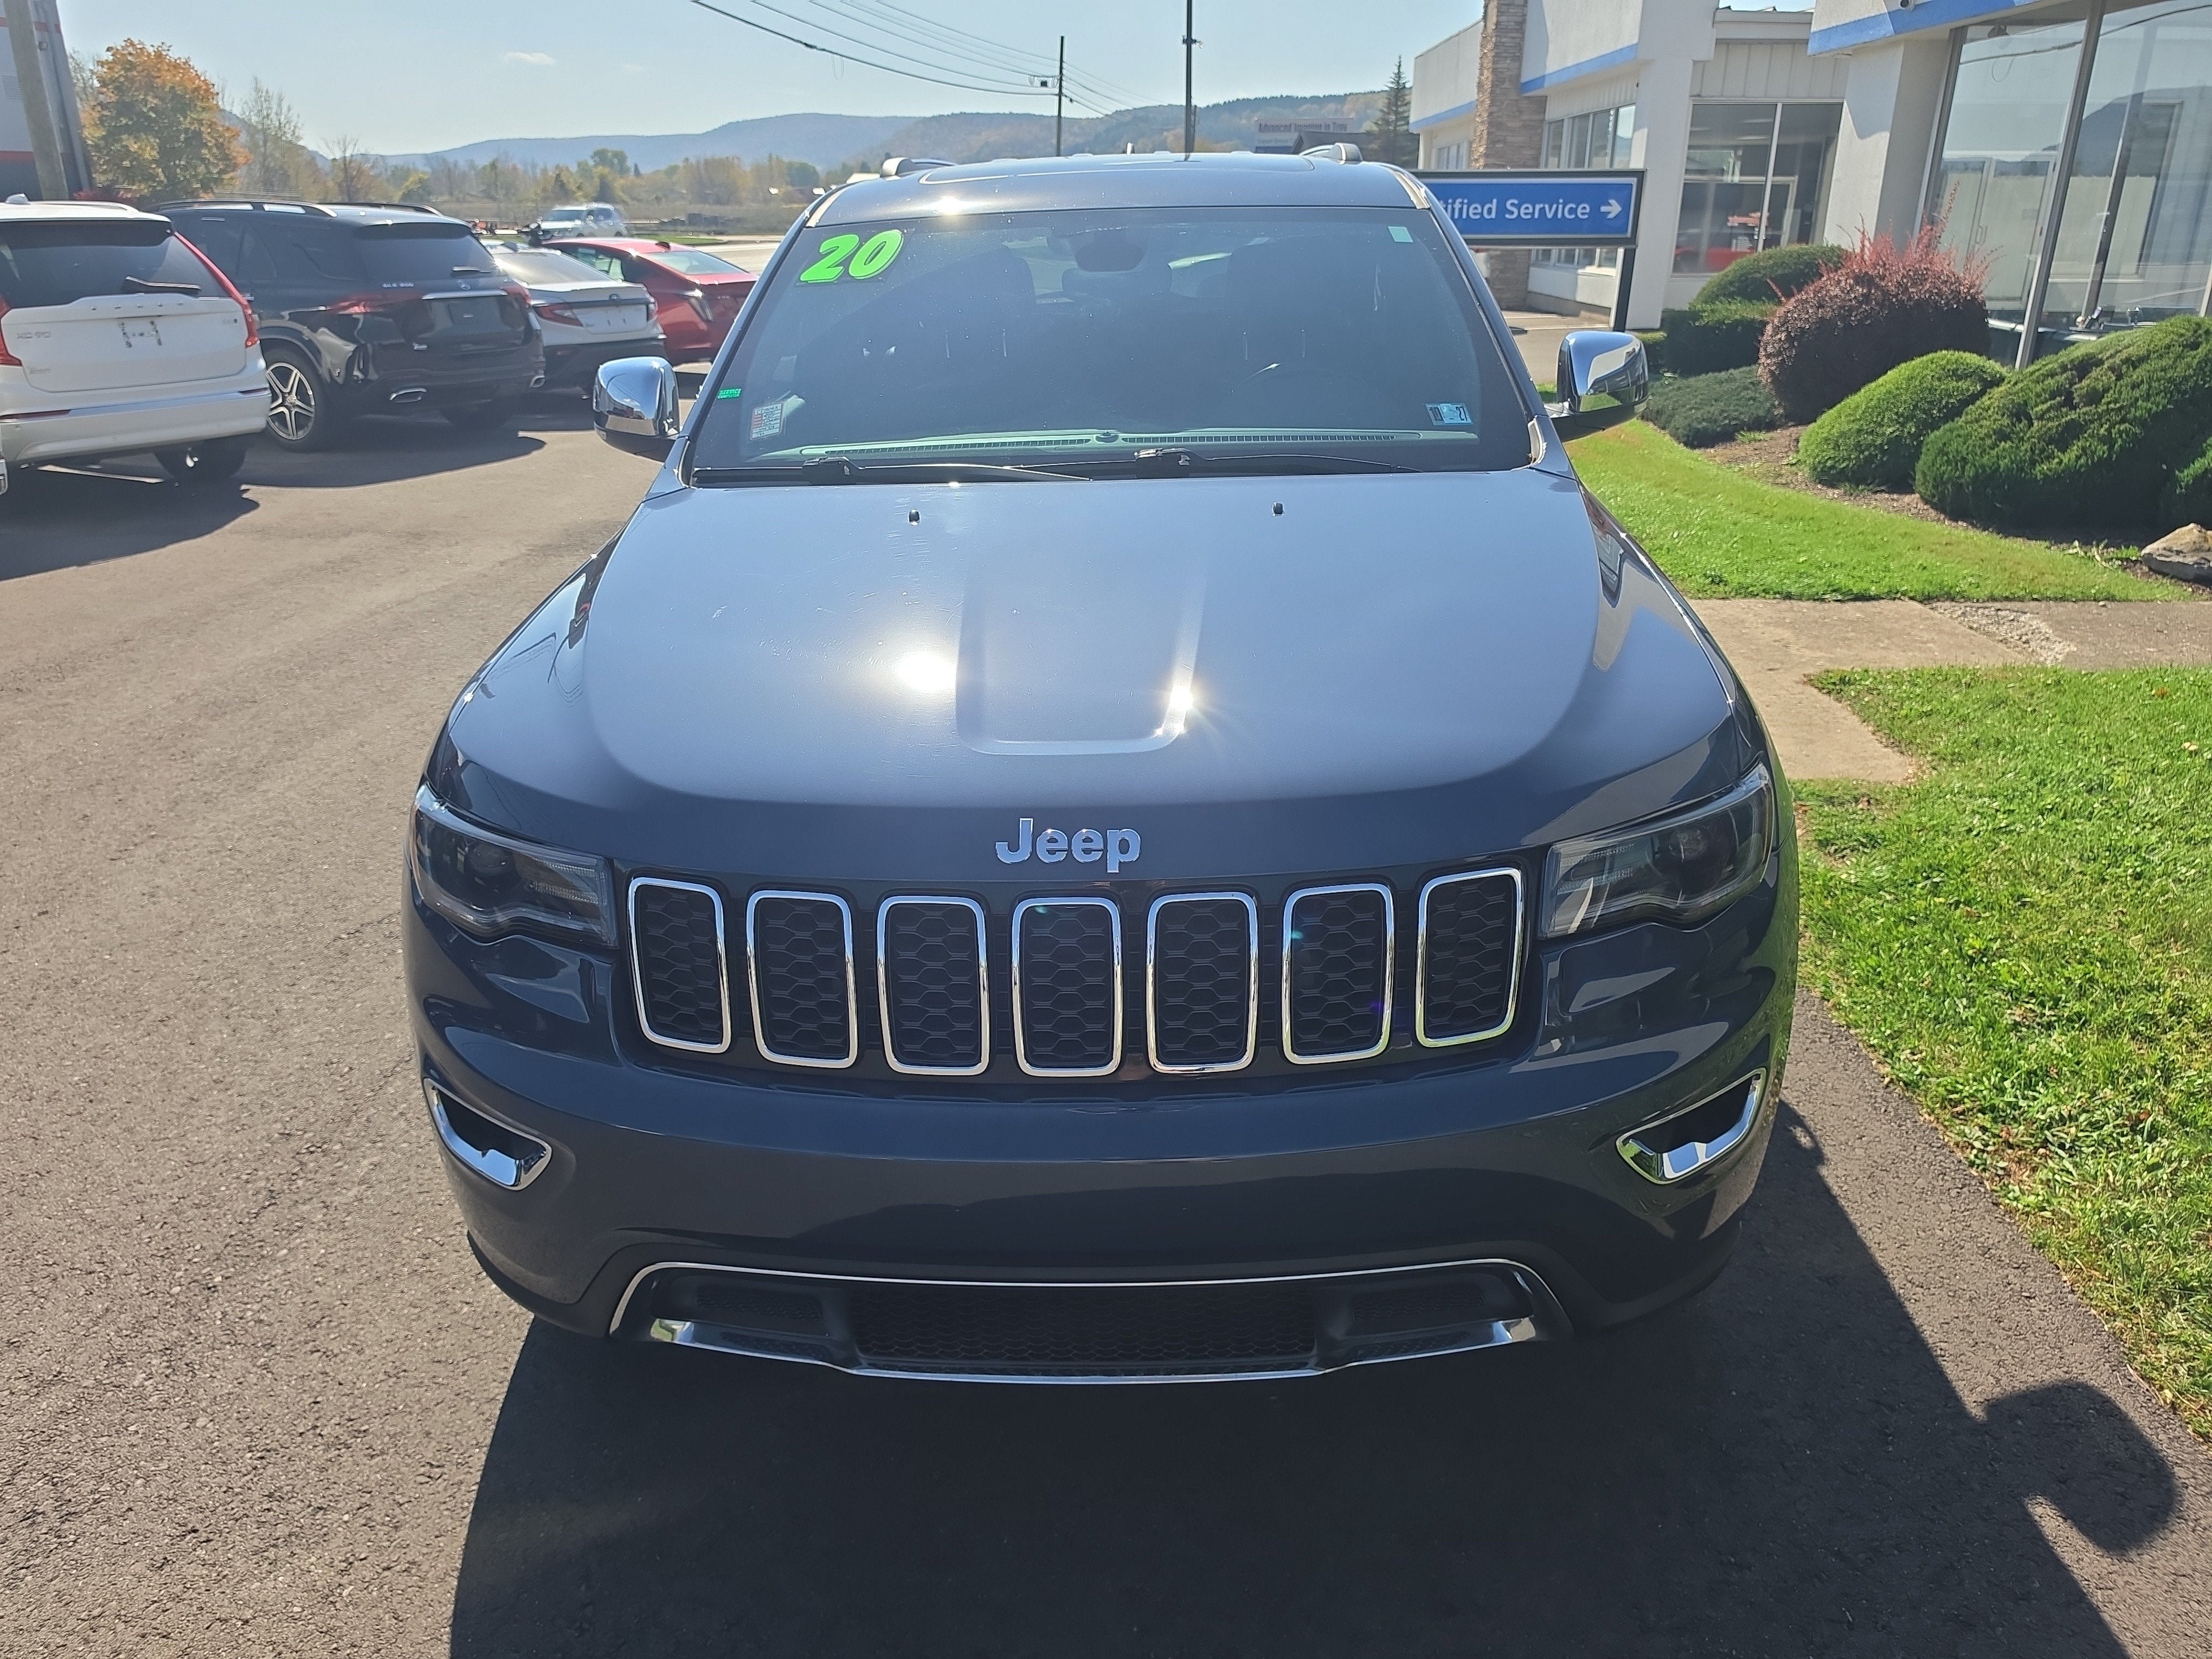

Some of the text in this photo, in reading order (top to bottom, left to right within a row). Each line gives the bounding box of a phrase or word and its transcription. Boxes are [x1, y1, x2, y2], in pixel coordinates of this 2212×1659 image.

[1504, 198, 1590, 220] Service
[800, 229, 904, 284] 20
[1455, 406, 1468, 421] 27
[995, 817, 1141, 873] Jeep
